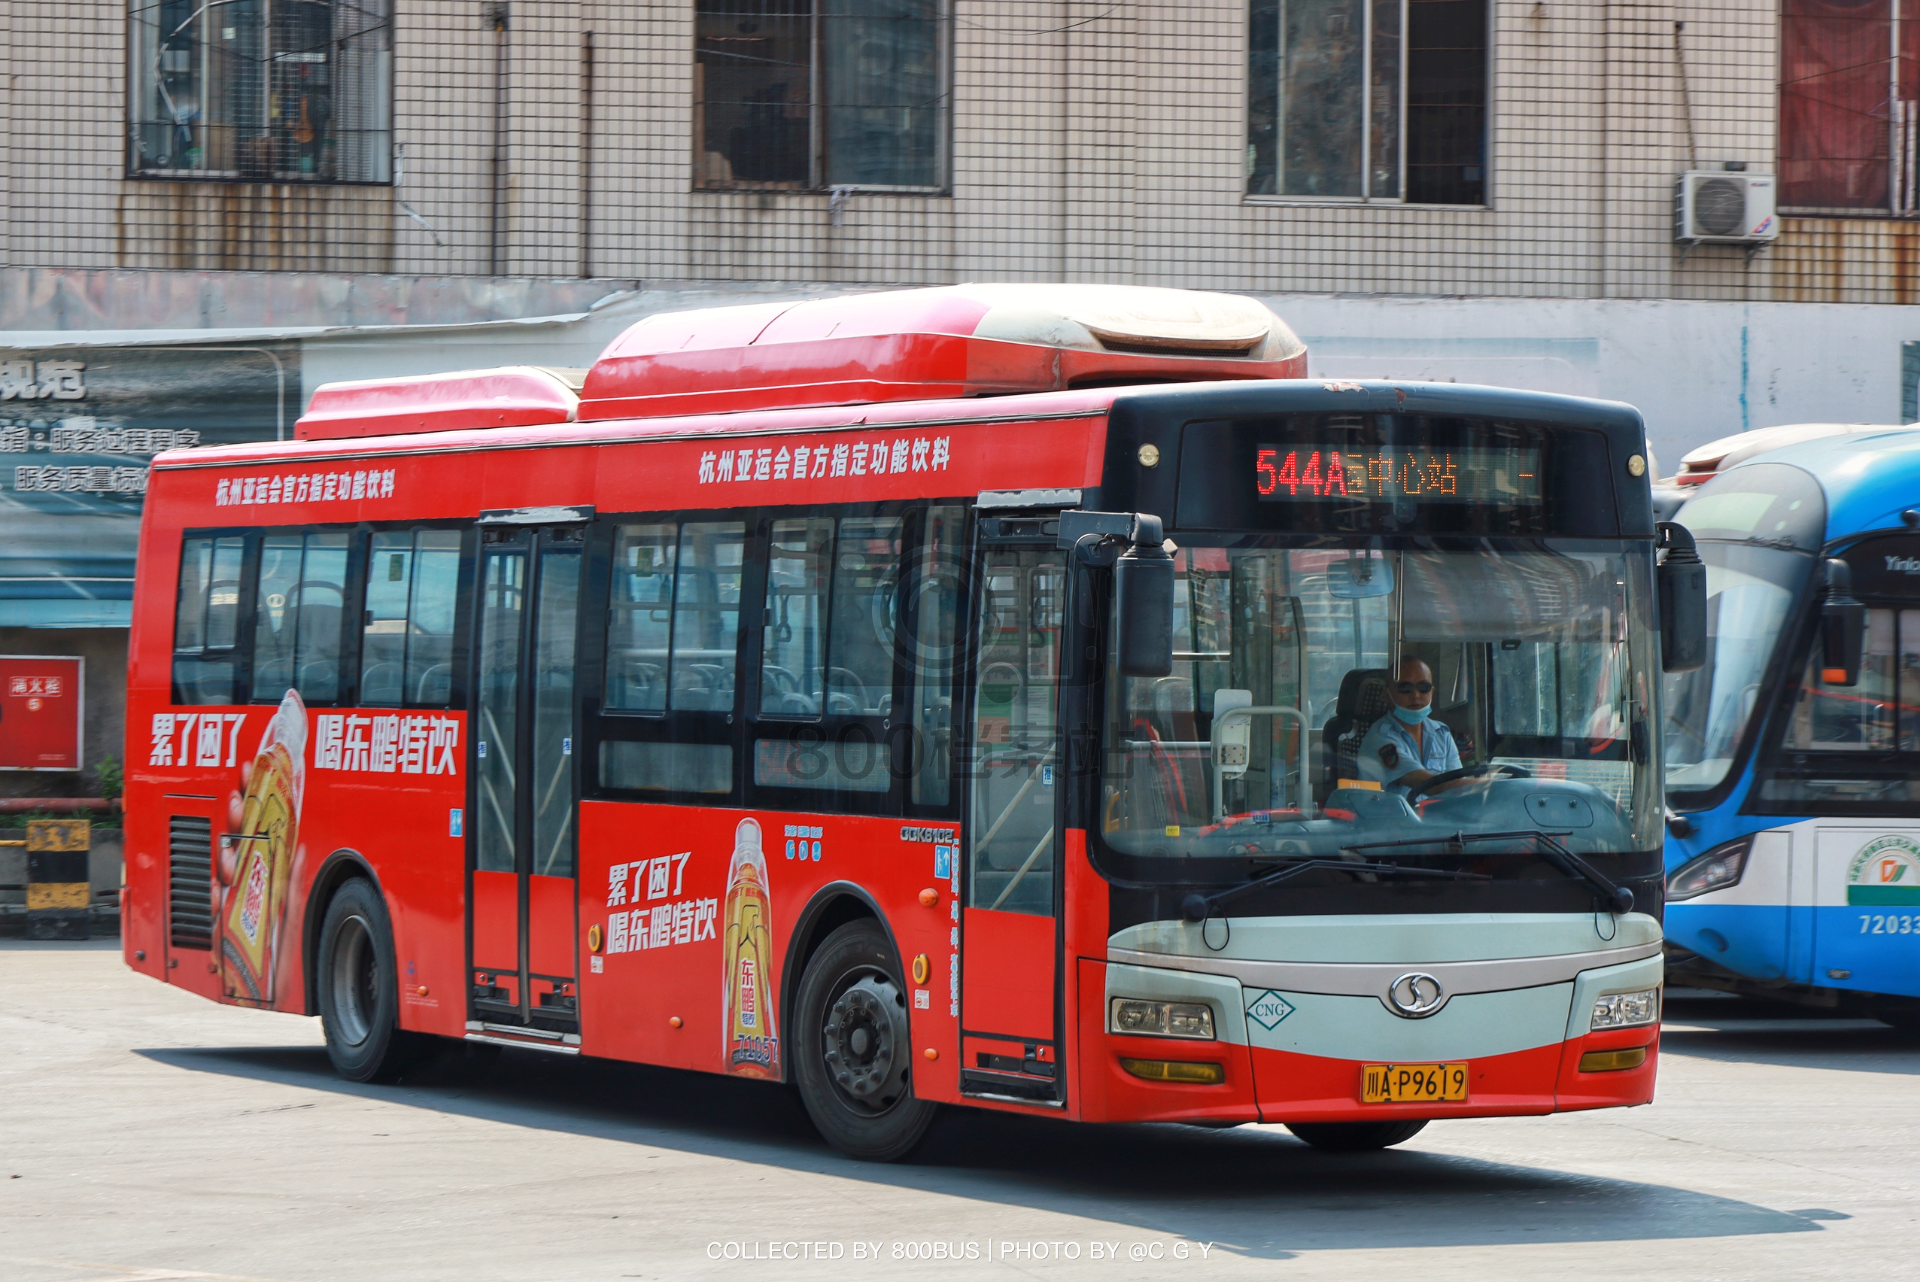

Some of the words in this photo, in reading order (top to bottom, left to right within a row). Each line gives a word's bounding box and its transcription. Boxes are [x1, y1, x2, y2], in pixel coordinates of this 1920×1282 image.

[698, 436, 951, 484] 杭州亚运会官方指定功能饮料
[1256, 450, 1347, 496] 544A
[215, 468, 396, 507] 杭州亚运会官方指定功能饮料
[12, 678, 60, 694] 消火栓
[29, 698, 40, 710] 5
[149, 713, 247, 768] 累了困了
[314, 713, 459, 776] 喝东鹏特饮
[606, 852, 691, 907] 累了困了
[606, 897, 718, 955] 喝东鹏特饮
[1255, 1003, 1285, 1017] CNG
